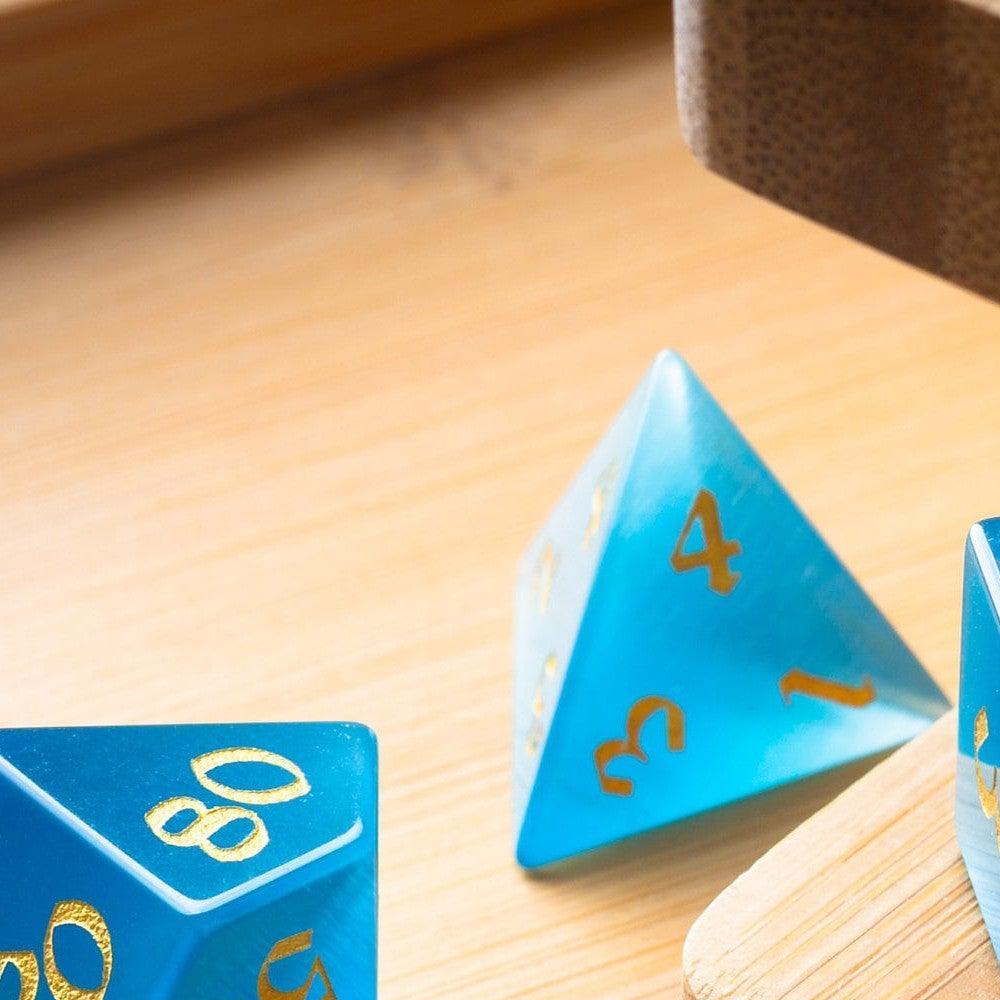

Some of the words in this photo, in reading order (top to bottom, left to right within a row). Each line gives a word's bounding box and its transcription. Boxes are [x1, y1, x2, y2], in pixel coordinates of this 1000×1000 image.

[670, 488, 741, 597] 4
[779, 668, 876, 709] 1
[594, 695, 685, 797] 3
[143, 746, 312, 863] 80
